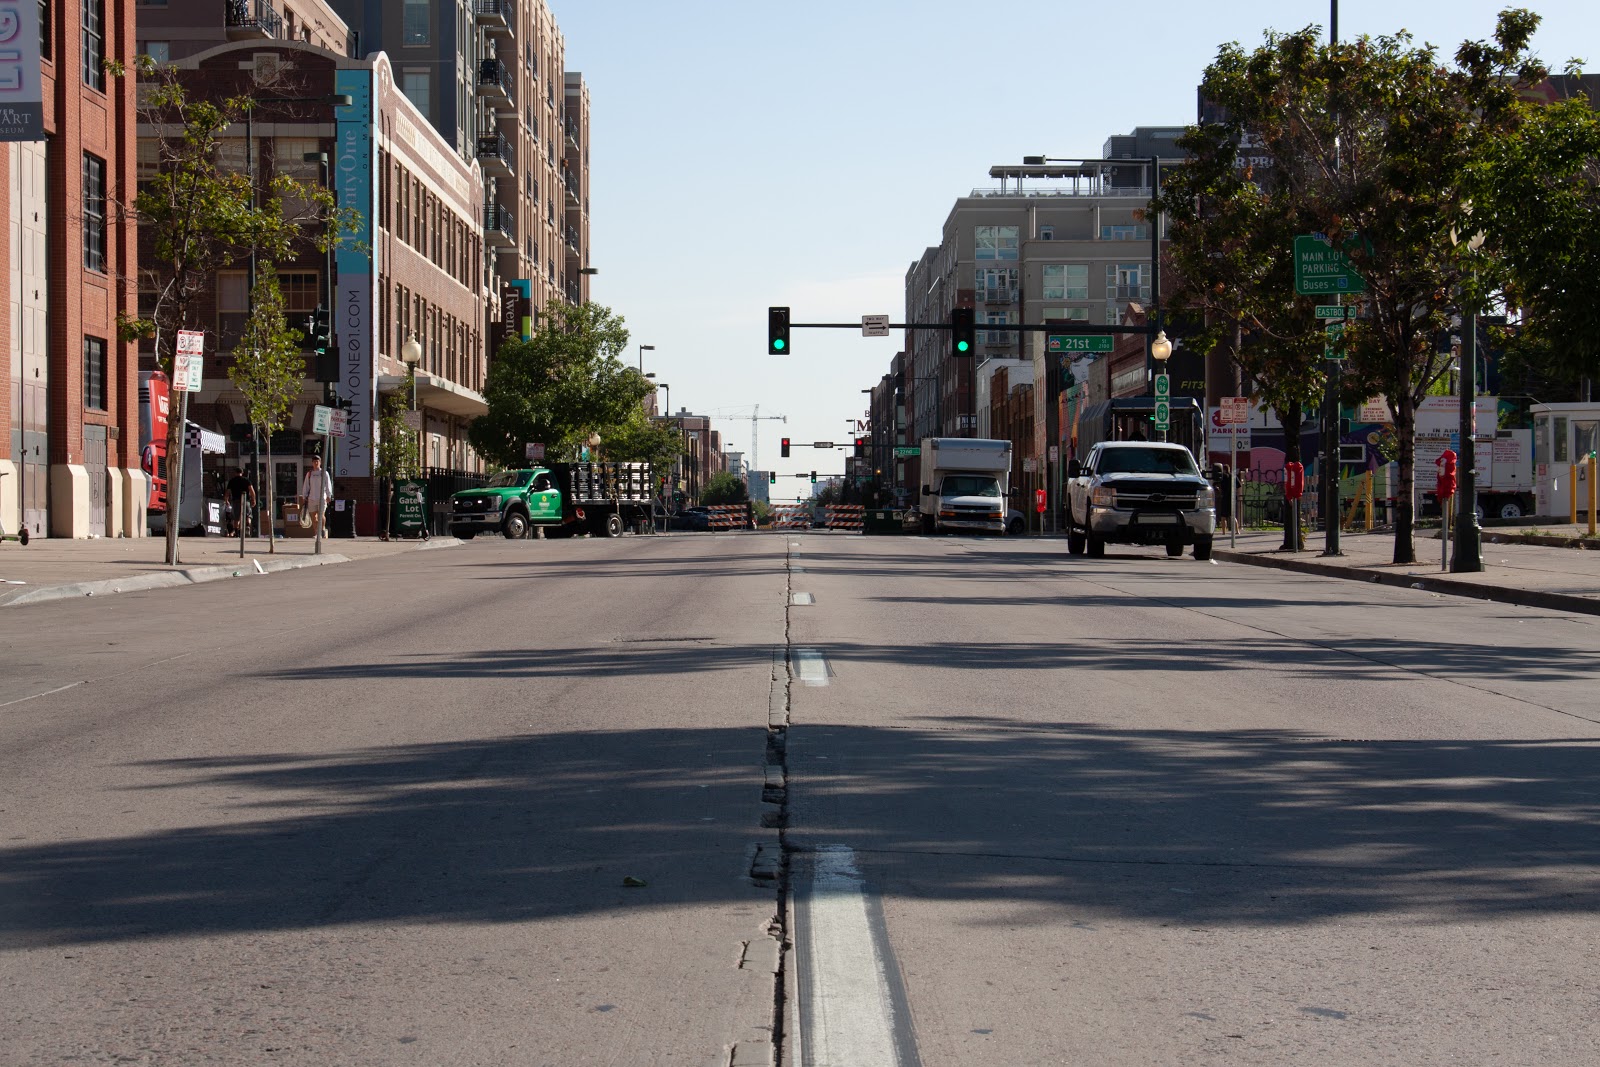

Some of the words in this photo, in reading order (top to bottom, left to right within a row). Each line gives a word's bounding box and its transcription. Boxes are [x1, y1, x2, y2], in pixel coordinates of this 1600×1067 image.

[363, 153, 368, 170] ON
[340, 130, 363, 241] TntyOne
[1302, 251, 1324, 261] MAIN
[1302, 263, 1340, 273] PARKING
[1303, 280, 1329, 290] Buses
[1065, 338, 1090, 349] 21st
[399, 496, 418, 505] Gate
